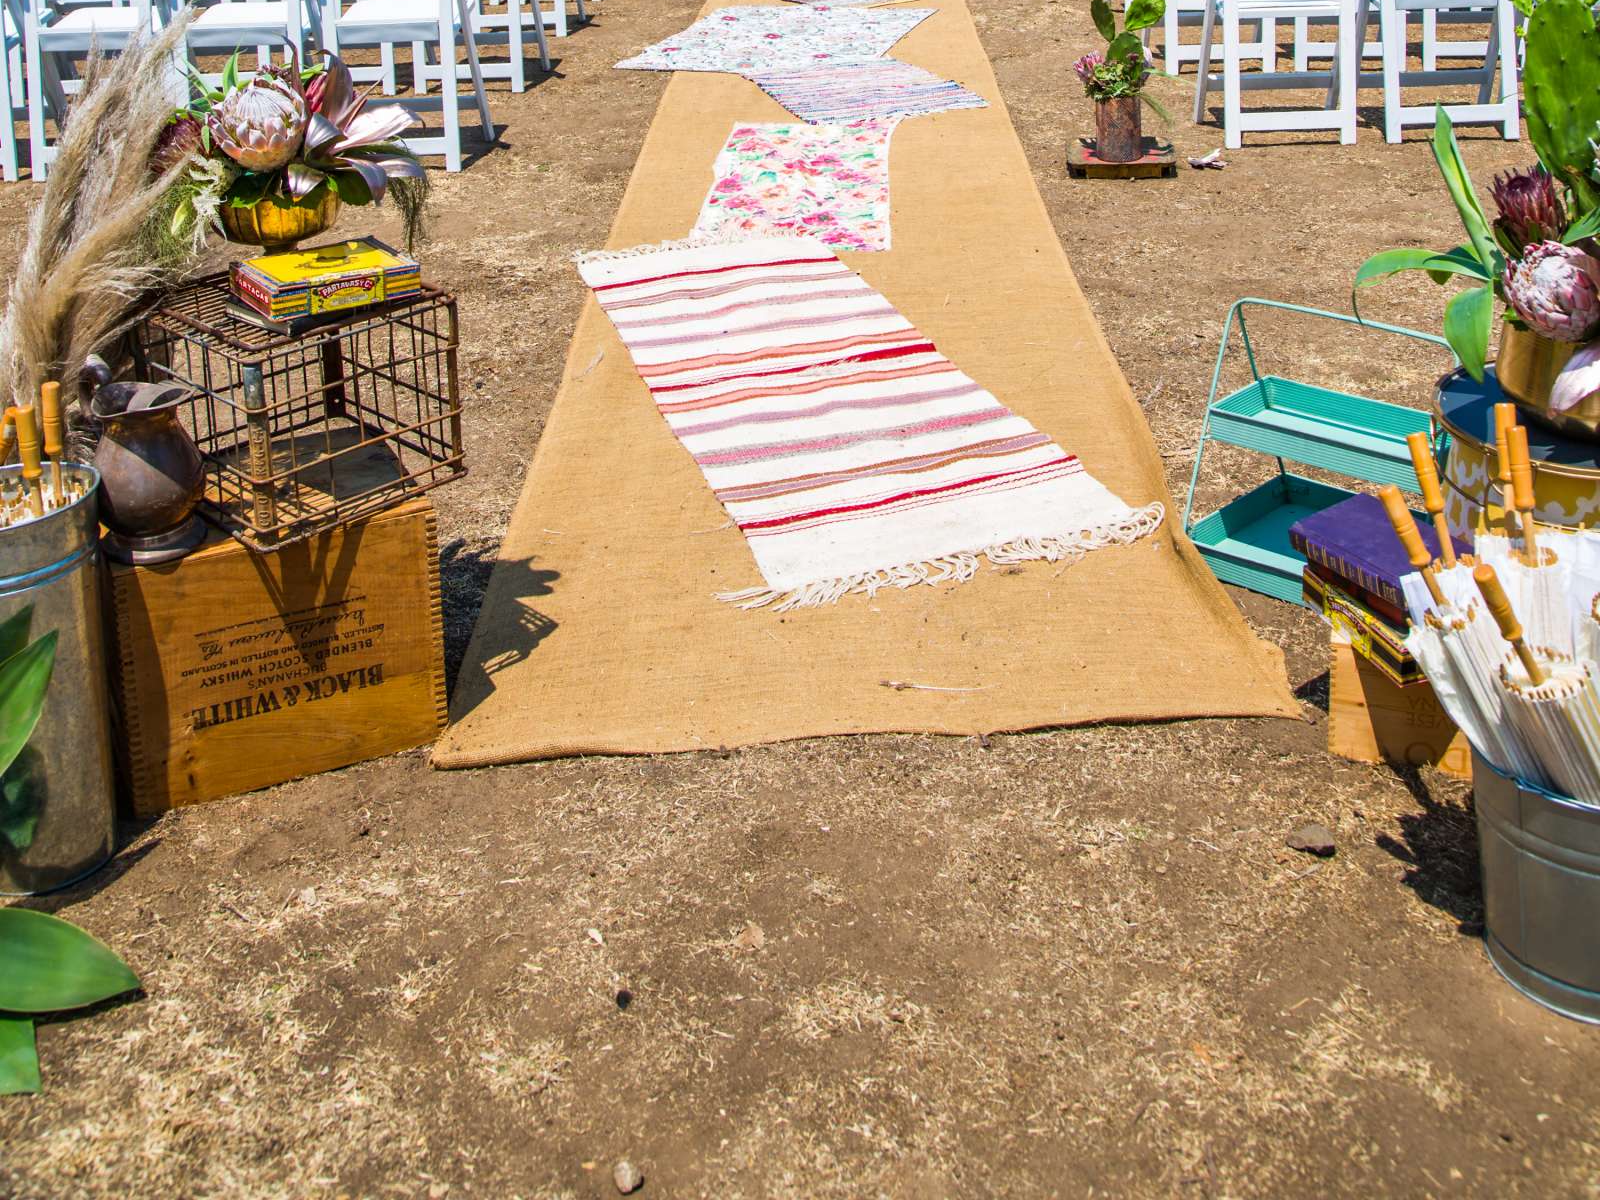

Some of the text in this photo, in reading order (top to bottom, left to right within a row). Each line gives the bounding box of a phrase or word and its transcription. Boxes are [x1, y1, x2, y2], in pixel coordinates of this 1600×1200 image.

[281, 643, 299, 654] AND
[301, 634, 339, 652] BLENDED
[200, 638, 373, 688] BLENDED SCOTCH WHISKY
[229, 658, 239, 667] IN
[242, 649, 279, 663] BOTTLED
[181, 660, 228, 678] SCOTLAND
[248, 661, 327, 689] BUCHANAN'S
[192, 663, 385, 731] BLACK & WHITE
